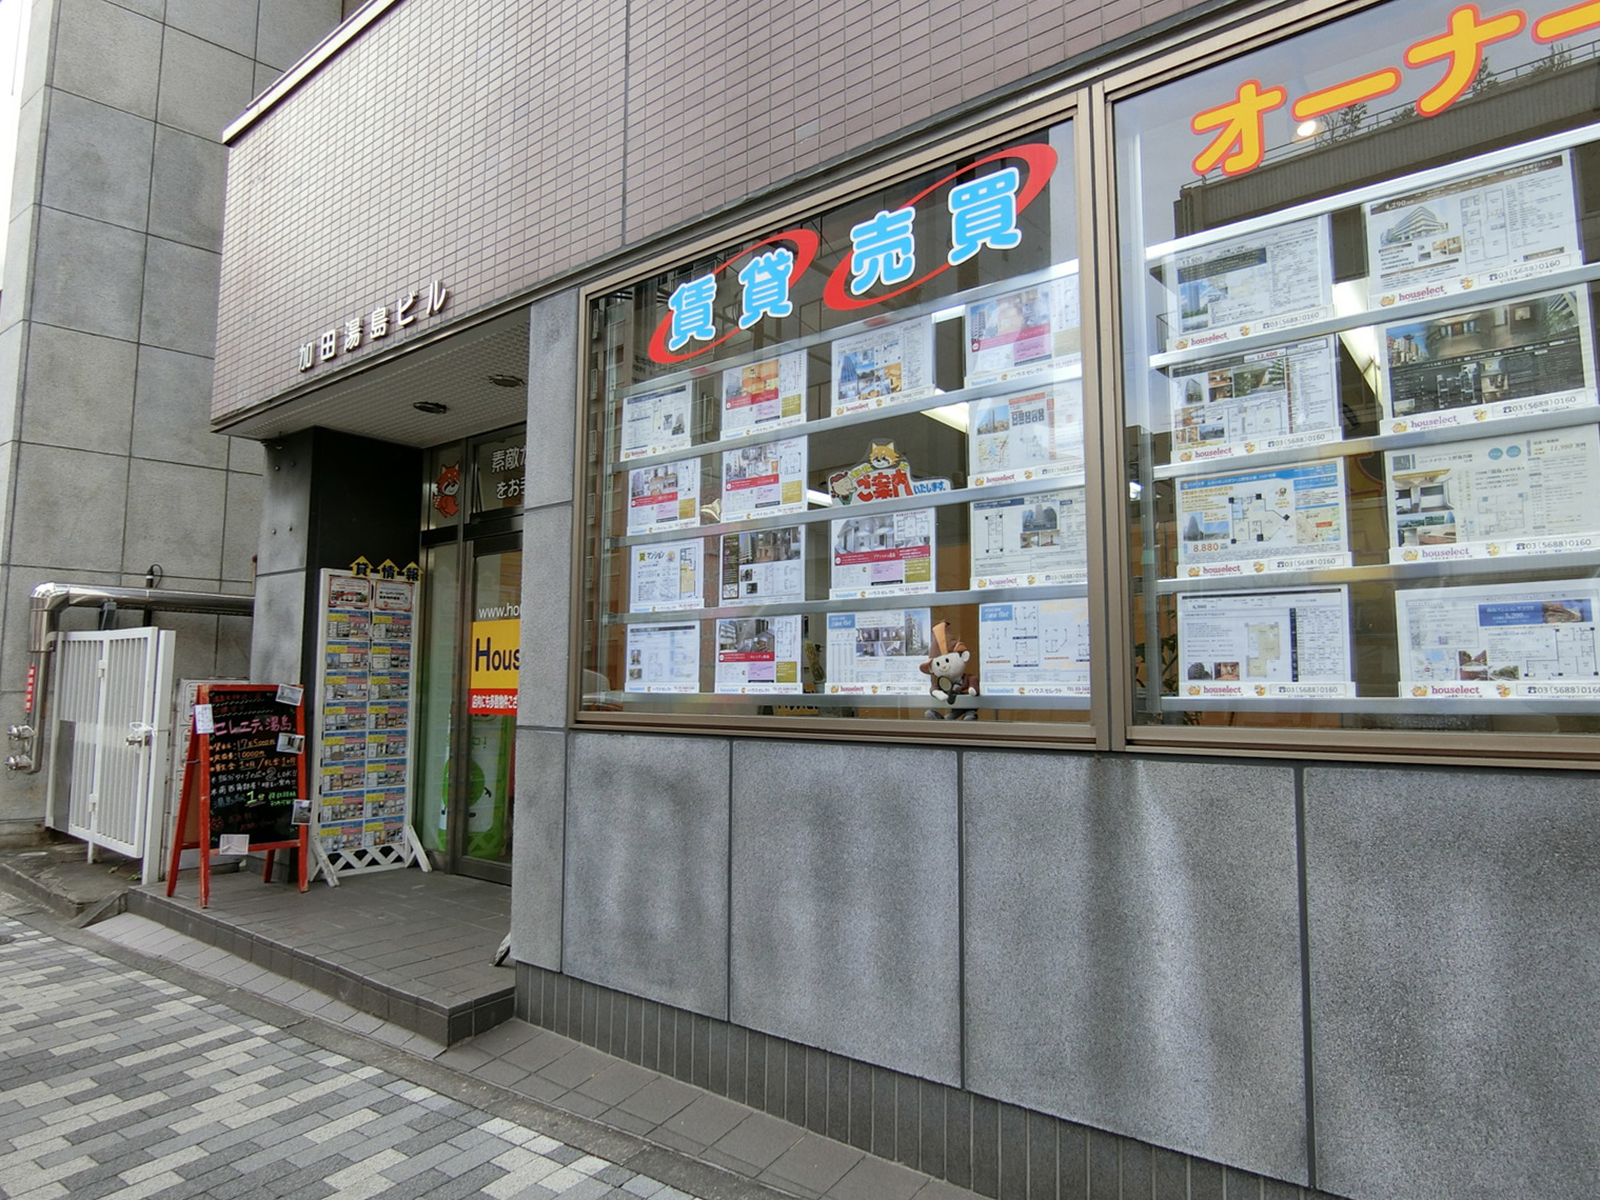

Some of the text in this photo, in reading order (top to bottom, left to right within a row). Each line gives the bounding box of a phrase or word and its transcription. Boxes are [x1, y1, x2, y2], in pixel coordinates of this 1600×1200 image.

[1191, 0, 1600, 177] オーナー
[668, 166, 1022, 352] 賃貸 売買
[1398, 285, 1445, 302] houselect
[299, 280, 447, 372] 加田湯島ビル
[1191, 332, 1228, 346] houselect
[1411, 415, 1458, 428] houselect
[1195, 446, 1232, 459] houselect
[986, 474, 1015, 484] houselect
[1422, 538, 1592, 559] houselect 03(5688)0160
[1203, 564, 1241, 574] houselect
[989, 577, 1017, 586] houselect
[1203, 685, 1339, 694] houselect 03(5688)0160
[1431, 685, 1480, 695] houselect
